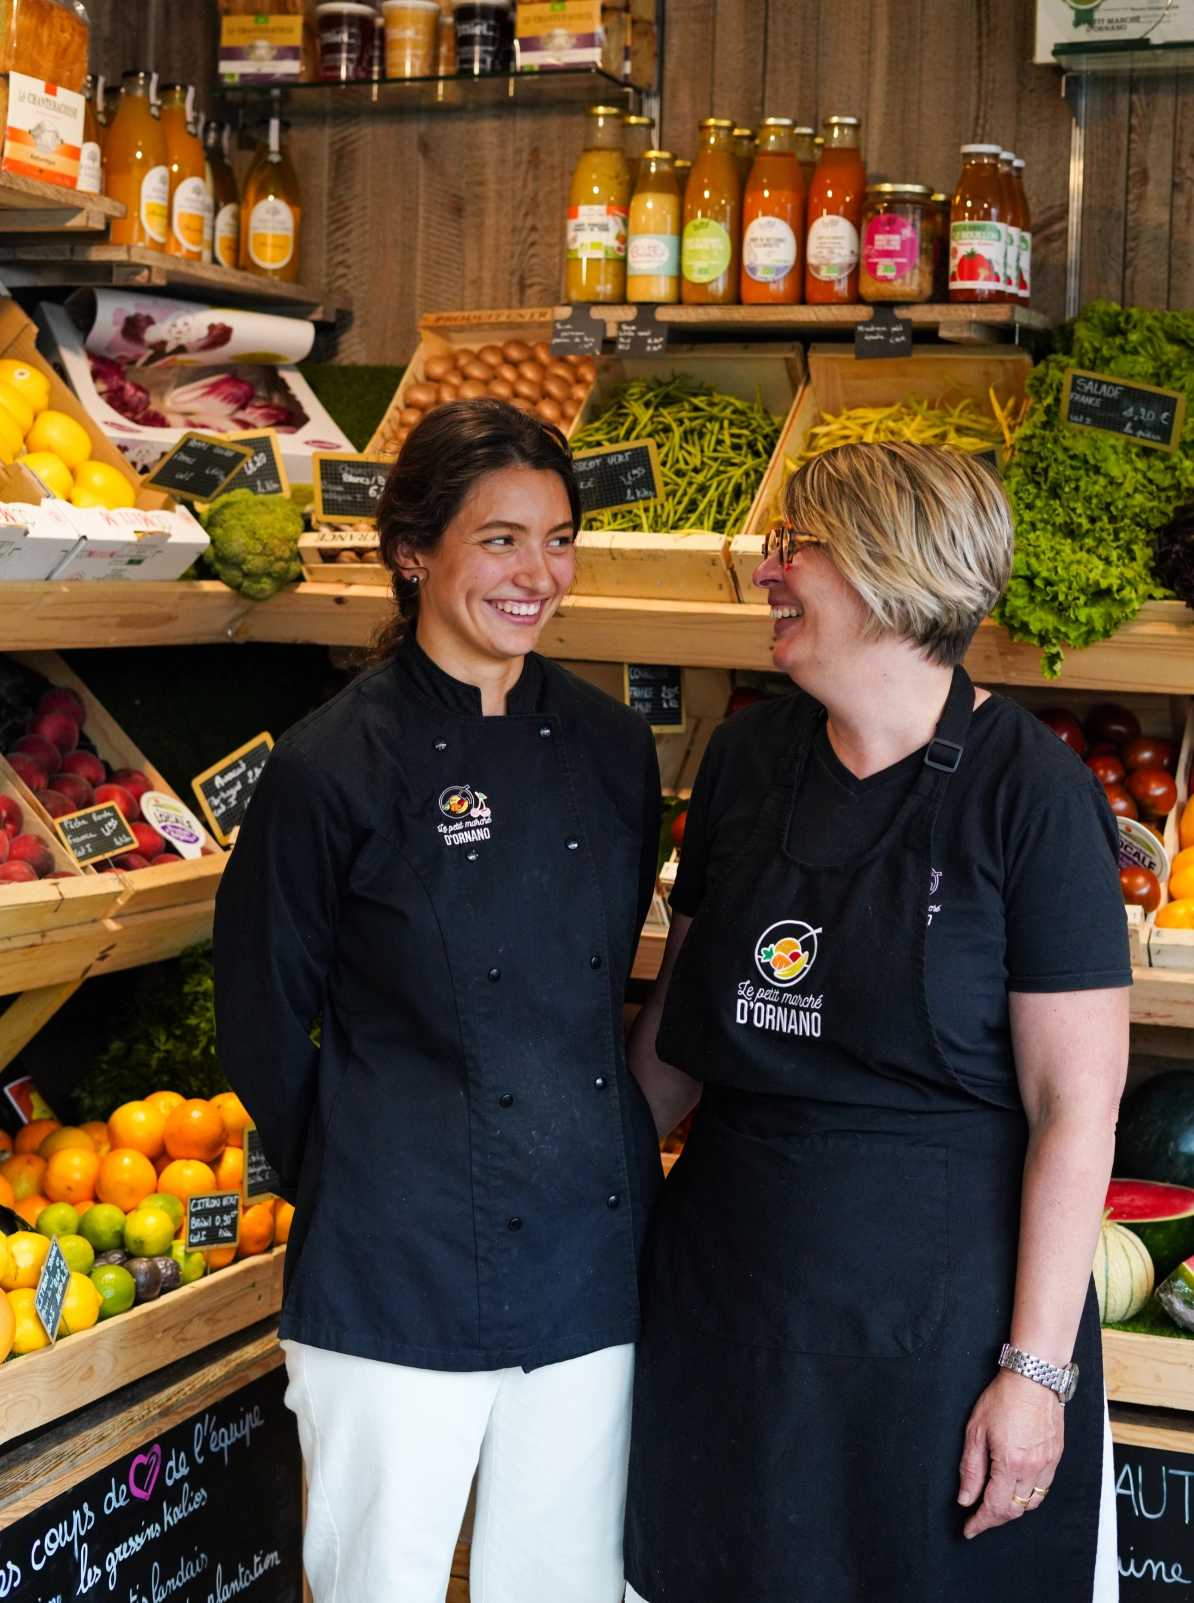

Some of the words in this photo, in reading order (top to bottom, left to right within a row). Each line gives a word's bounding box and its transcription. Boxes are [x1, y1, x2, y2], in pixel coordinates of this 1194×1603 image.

[1070, 391, 1102, 408] FRANCE
[1076, 378, 1125, 399] SALADE
[437, 823, 448, 834] Le
[448, 820, 464, 834] petit
[464, 814, 493, 828] marché
[443, 827, 491, 846] D'ORNANO
[737, 980, 755, 1001] Le
[754, 986, 780, 1003] petit
[781, 992, 824, 1010] marché
[736, 998, 822, 1038] D'ORNANO
[190, 1198, 221, 1212] CITRON
[31, 1502, 95, 1571] coups
[103, 1477, 130, 1515] de
[165, 1448, 190, 1487] de
[193, 1404, 265, 1467] l'équipe
[76, 1543, 102, 1596] les
[105, 1520, 162, 1591] gressins
[151, 1546, 209, 1603] landais
